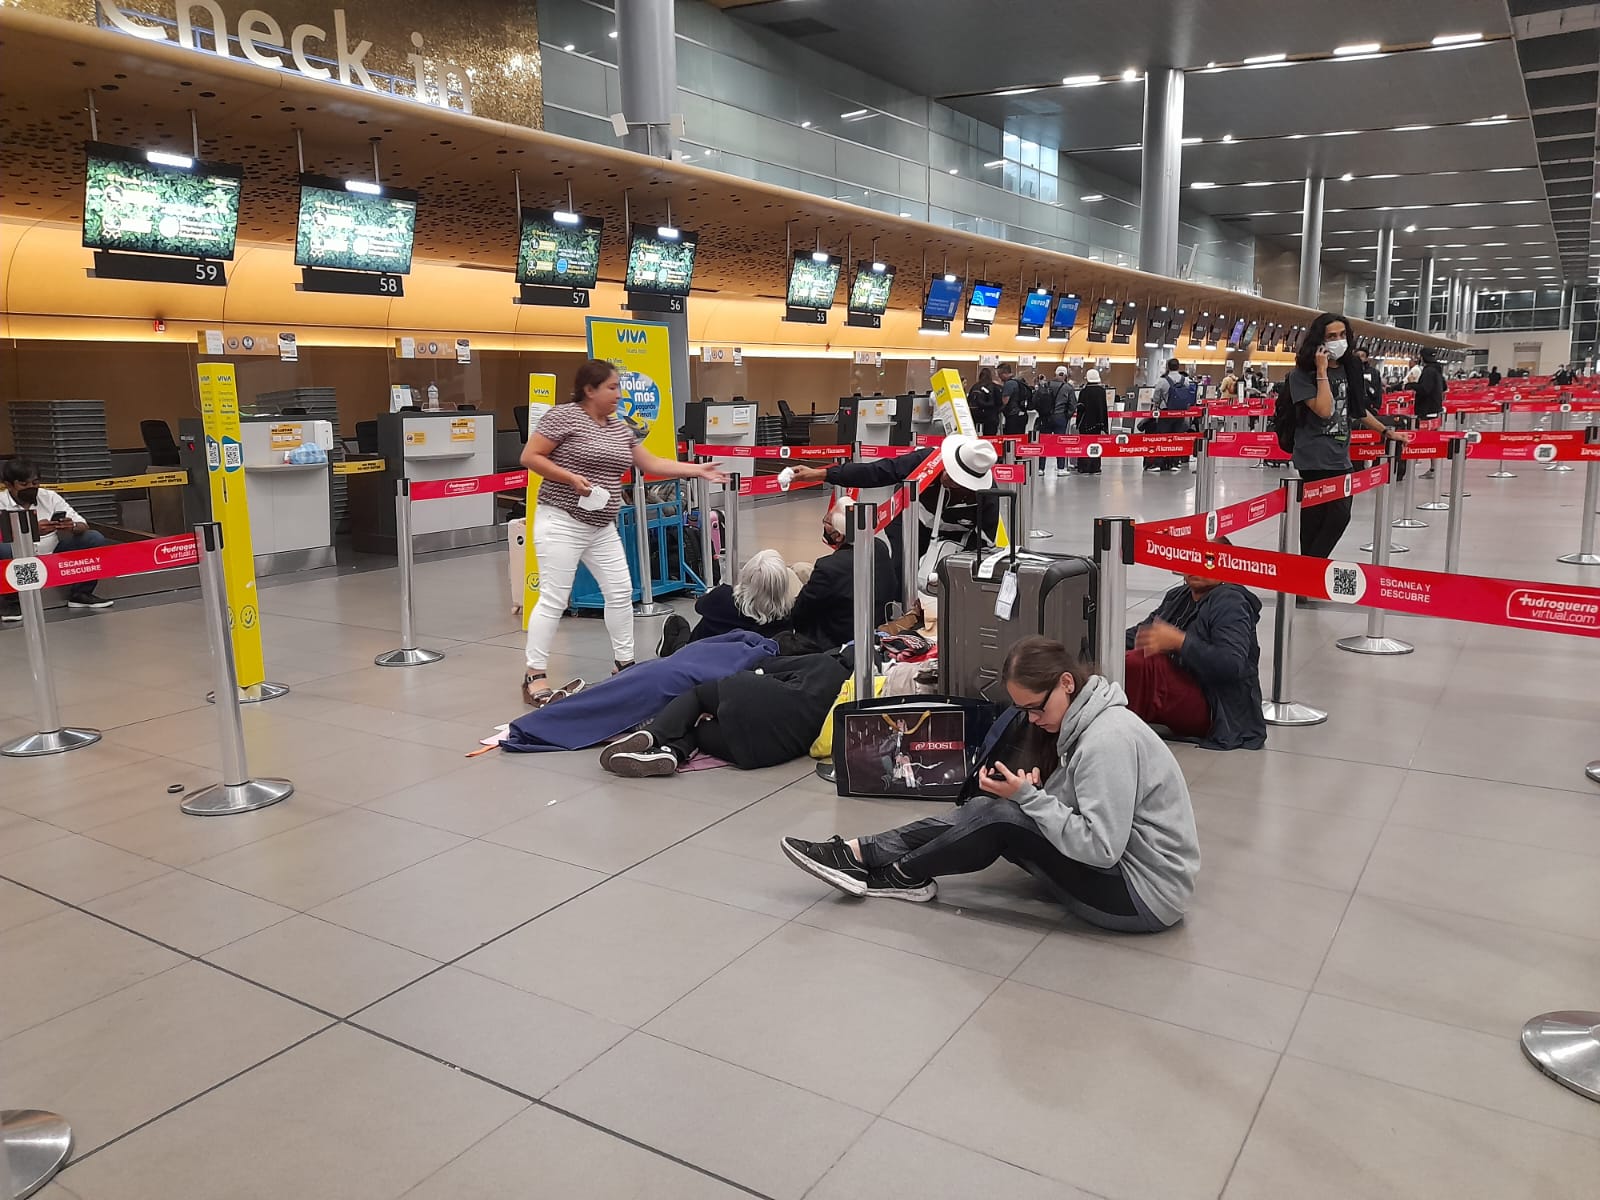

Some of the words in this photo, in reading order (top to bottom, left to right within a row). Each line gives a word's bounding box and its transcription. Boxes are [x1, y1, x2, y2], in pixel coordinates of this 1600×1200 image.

[406, 31, 473, 114] in
[195, 264, 217, 281] 59
[380, 278, 397, 292] 58
[572, 292, 585, 304] 57
[670, 299, 681, 311] 56
[816, 312, 825, 322] 55
[617, 328, 647, 344] VIVA
[58, 559, 95, 569] ESCANEA
[60, 564, 102, 577] DESCUBRE
[1218, 552, 1277, 576] Alemana
[1380, 577, 1423, 591] ESCANEA
[1424, 584, 1431, 592] Y
[1380, 588, 1431, 603] DESCUBRE
[1532, 608, 1596, 624] virtual.com
[928, 742, 953, 750] BOSI
